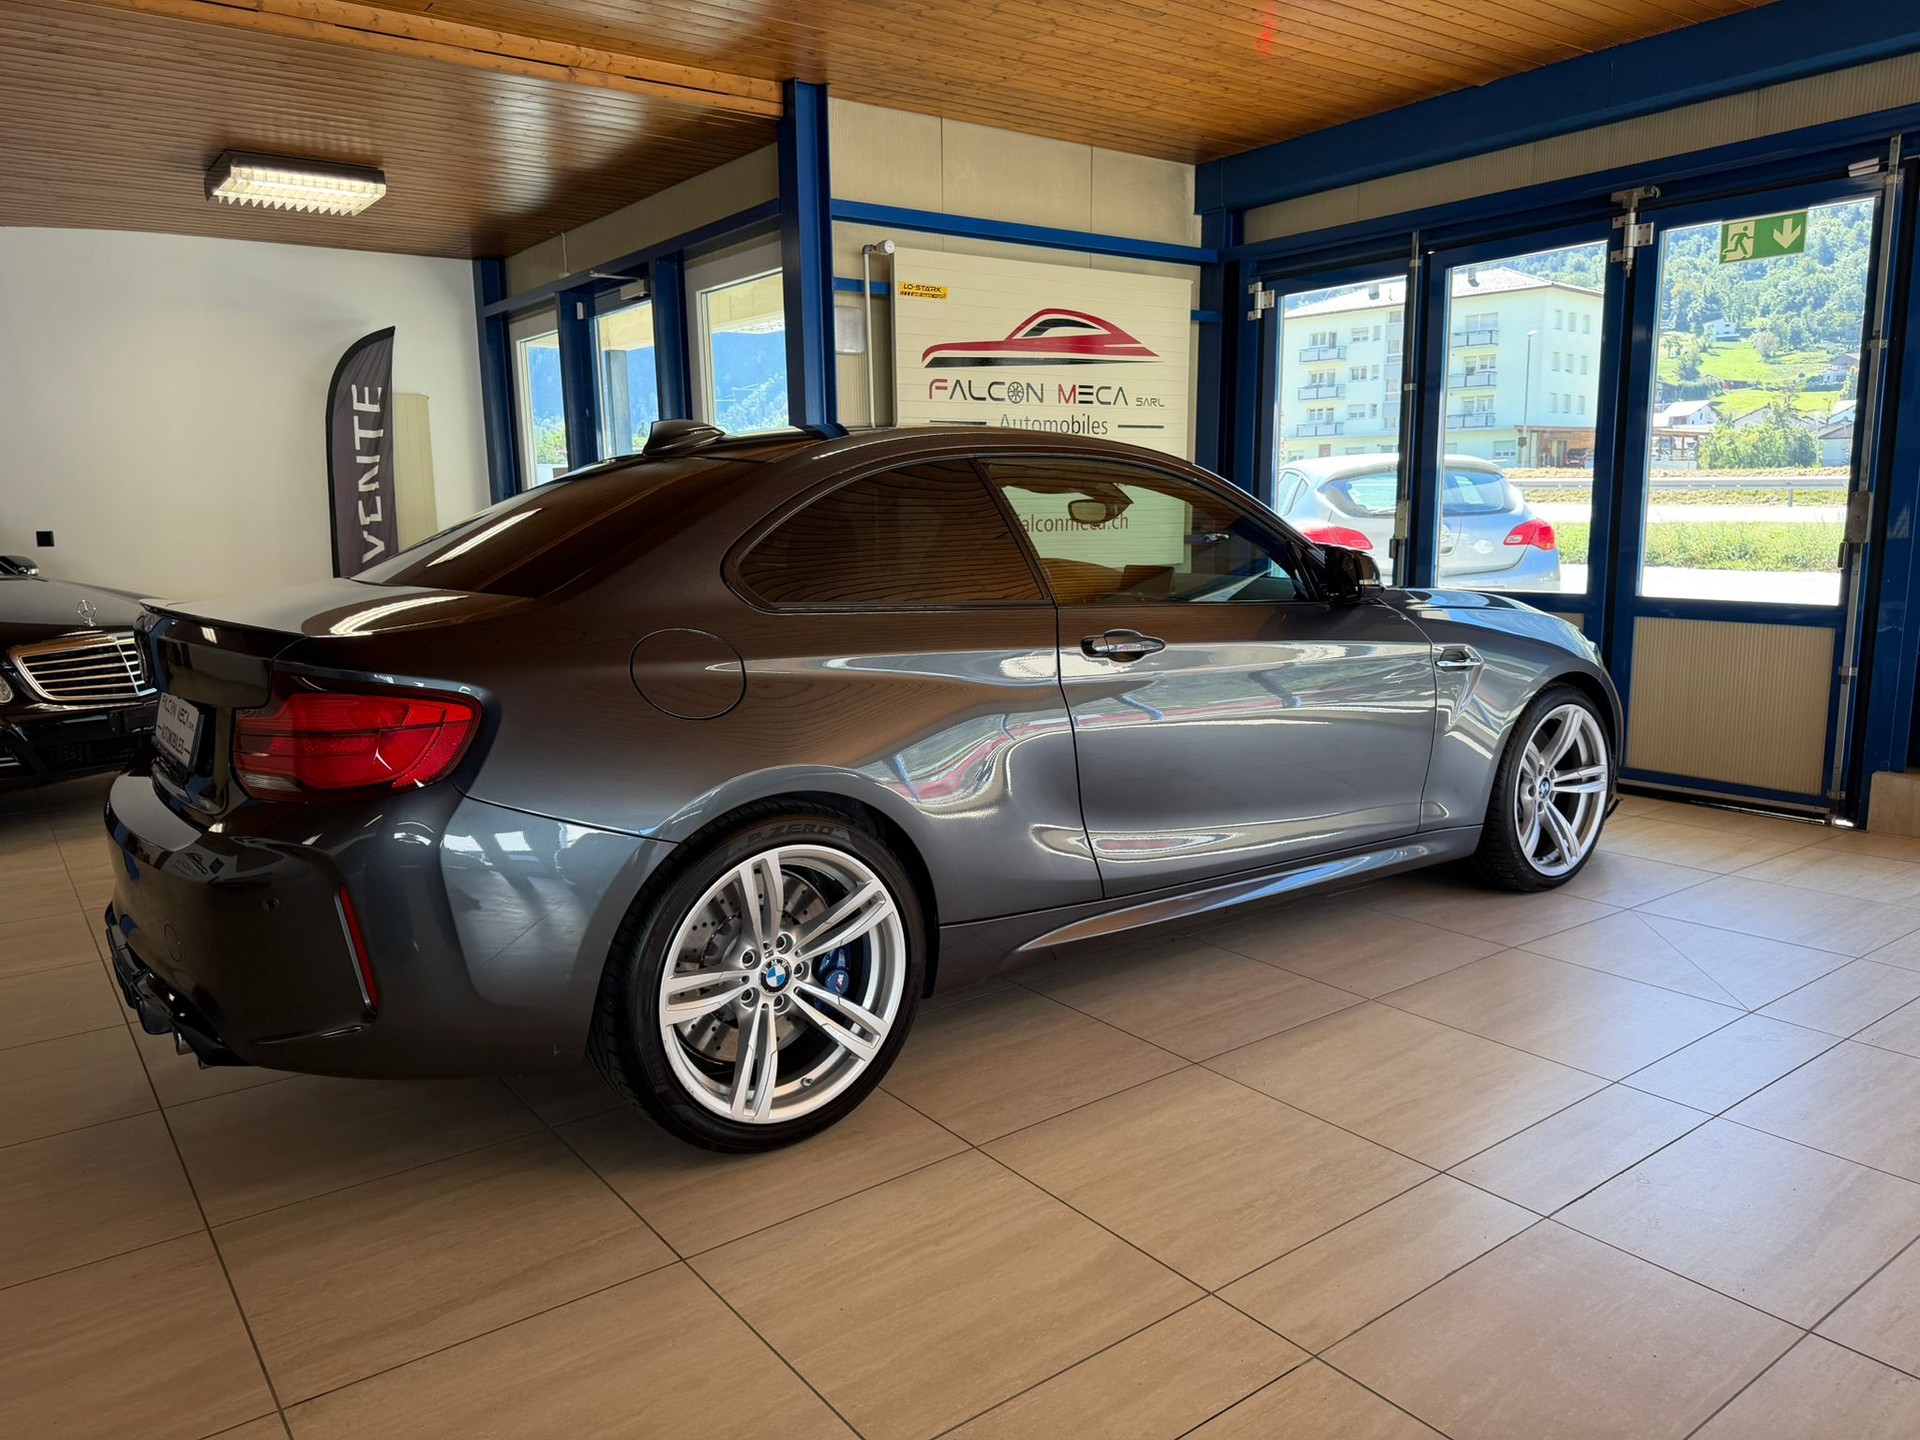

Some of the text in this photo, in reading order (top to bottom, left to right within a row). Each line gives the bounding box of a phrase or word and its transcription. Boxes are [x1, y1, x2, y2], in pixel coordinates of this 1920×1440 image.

[929, 378, 1165, 408] FALCON MECA SARL
[1000, 413, 1108, 435] Automobiles
[351, 384, 386, 563] VENTE
[1017, 513, 1129, 533] alconmeca.ch
